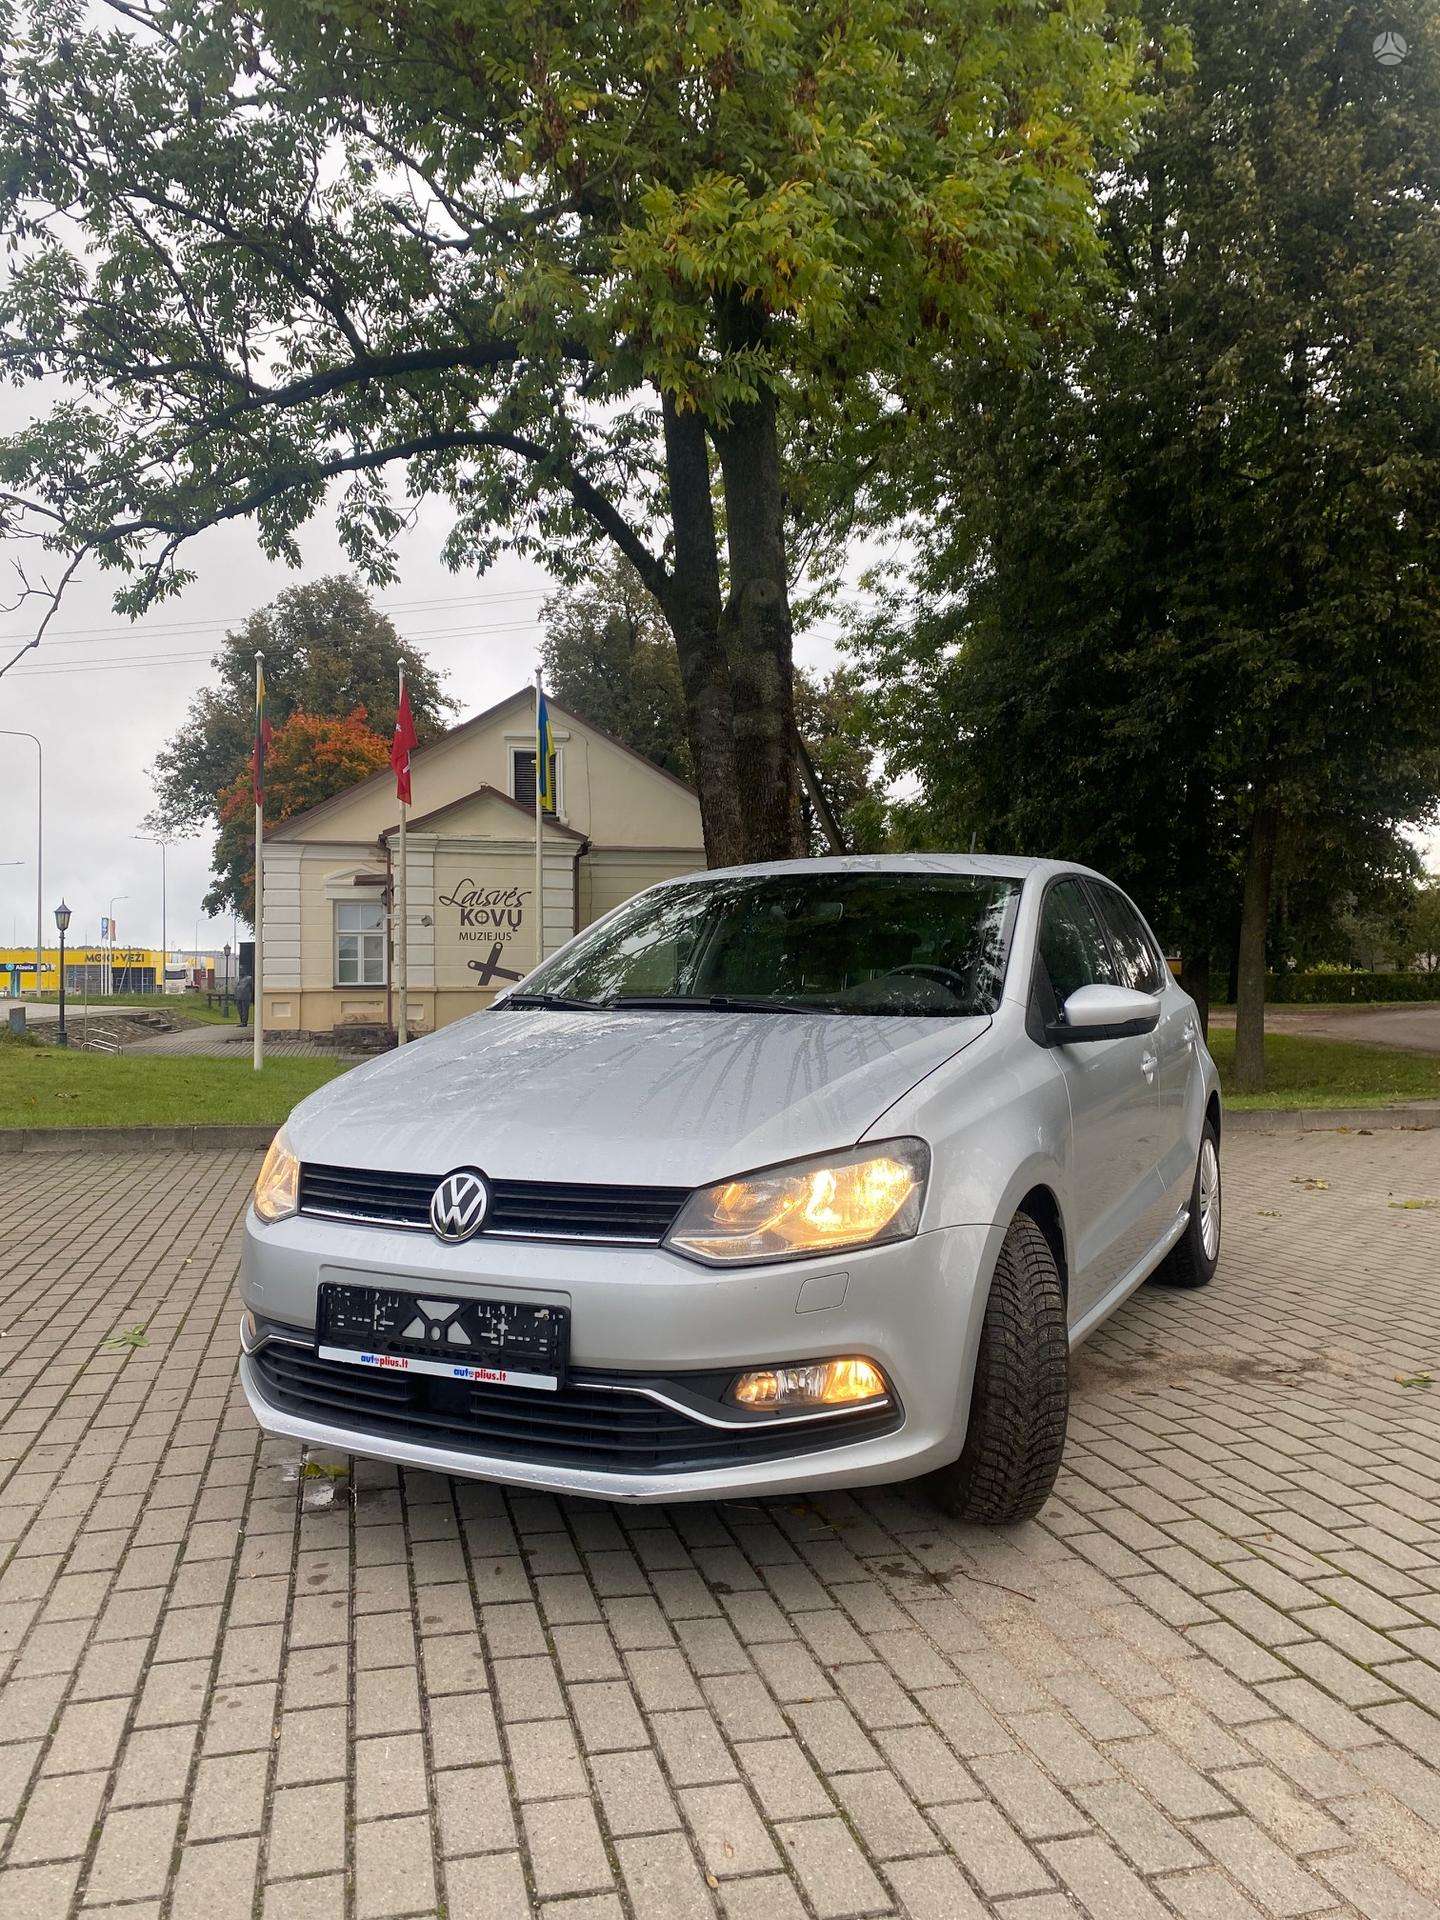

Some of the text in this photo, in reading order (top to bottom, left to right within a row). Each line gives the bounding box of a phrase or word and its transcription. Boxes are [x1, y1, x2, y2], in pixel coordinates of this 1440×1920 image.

[439, 878, 531, 907] Laisvės
[460, 909, 522, 932] KOVŲ
[459, 931, 512, 941] MUZIEJUS
[361, 1354, 408, 1368] autoplius.lt
[453, 1367, 506, 1381] autoplius.lt
